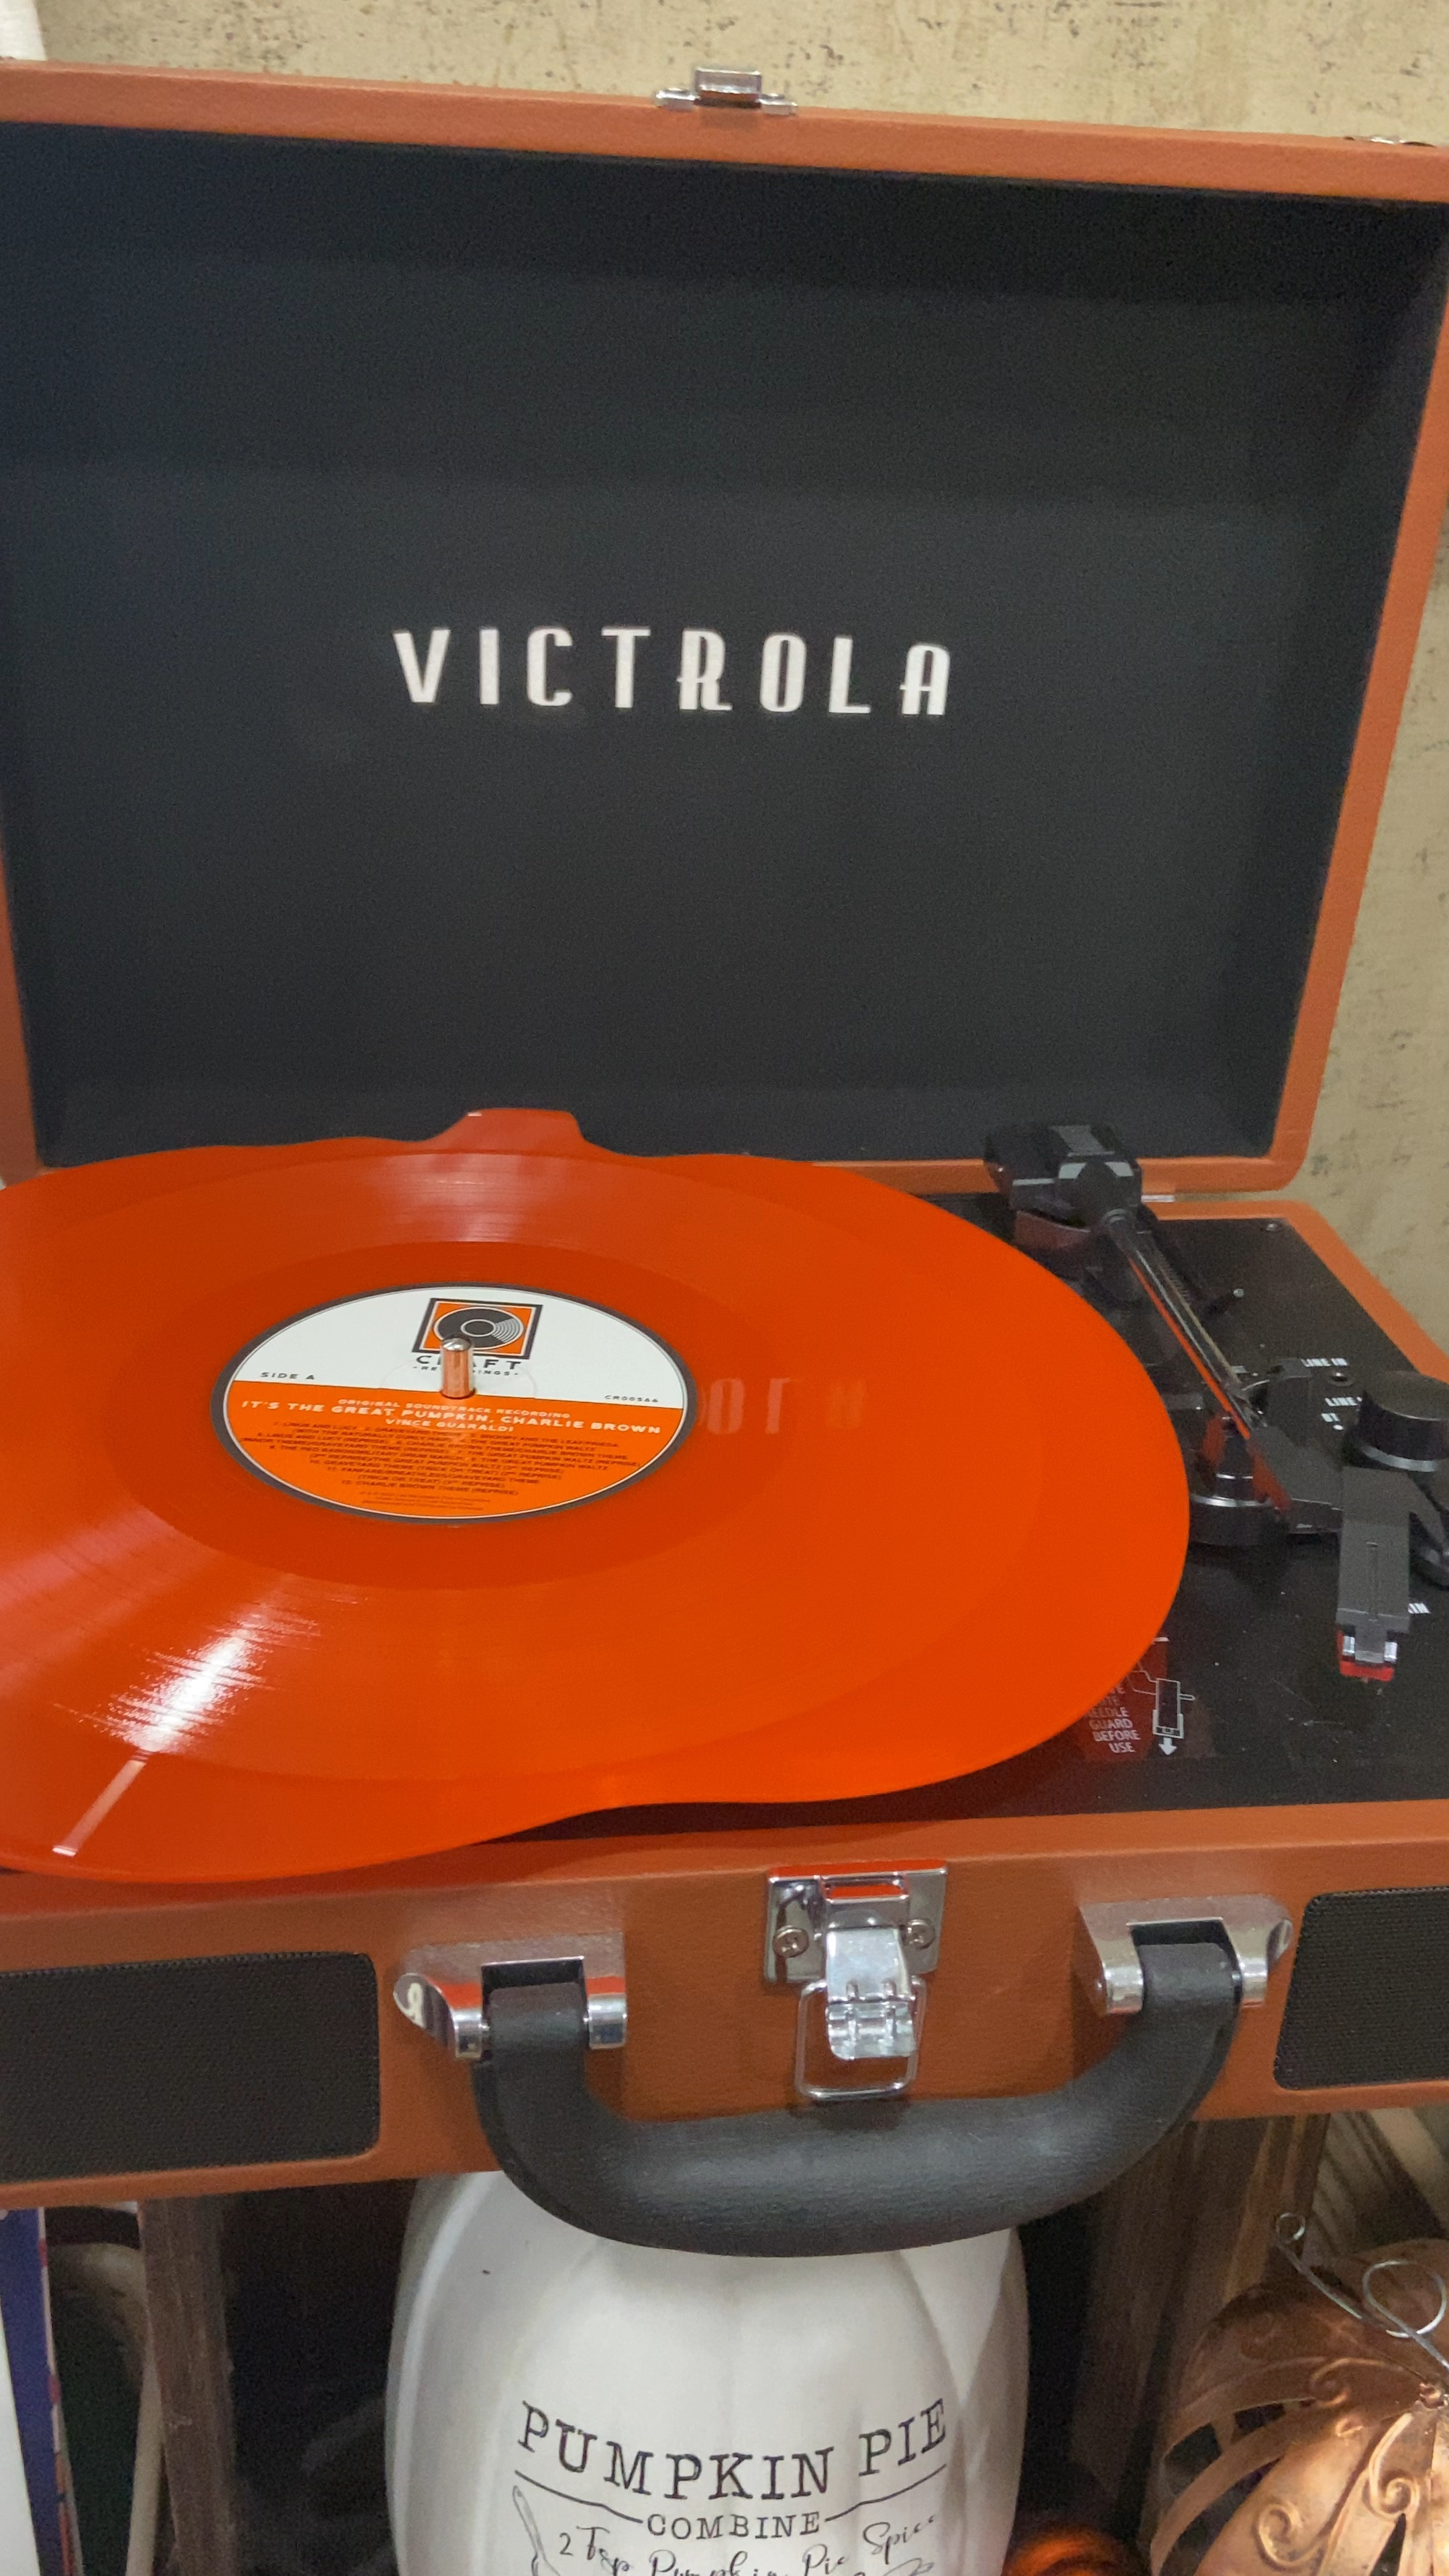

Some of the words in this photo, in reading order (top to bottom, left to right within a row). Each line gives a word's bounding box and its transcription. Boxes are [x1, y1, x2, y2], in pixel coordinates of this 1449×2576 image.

[393, 628, 951, 715] VICTROLA
[416, 1356, 521, 1369] CFT
[421, 1366, 509, 1375] REINGS
[337, 1399, 400, 1407] ORIGINAL
[496, 1409, 570, 1418] RECORDING
[241, 1401, 279, 1409] IT'S
[287, 1403, 324, 1412] THE
[331, 1406, 395, 1416] GREAT
[501, 1415, 584, 1429] CHARLIE
[590, 1422, 661, 1434] BROWN
[436, 1421, 514, 1432] GUARALDI
[1089, 1718, 1134, 1730] GUARD
[1093, 1729, 1140, 1741] BEFORE
[1109, 1742, 1136, 1754] USE
[515, 2400, 835, 2501] PUMPKIN
[858, 2398, 947, 2477] PIE
[647, 2512, 820, 2540] COMBINE
[559, 2532, 574, 2557] 2
